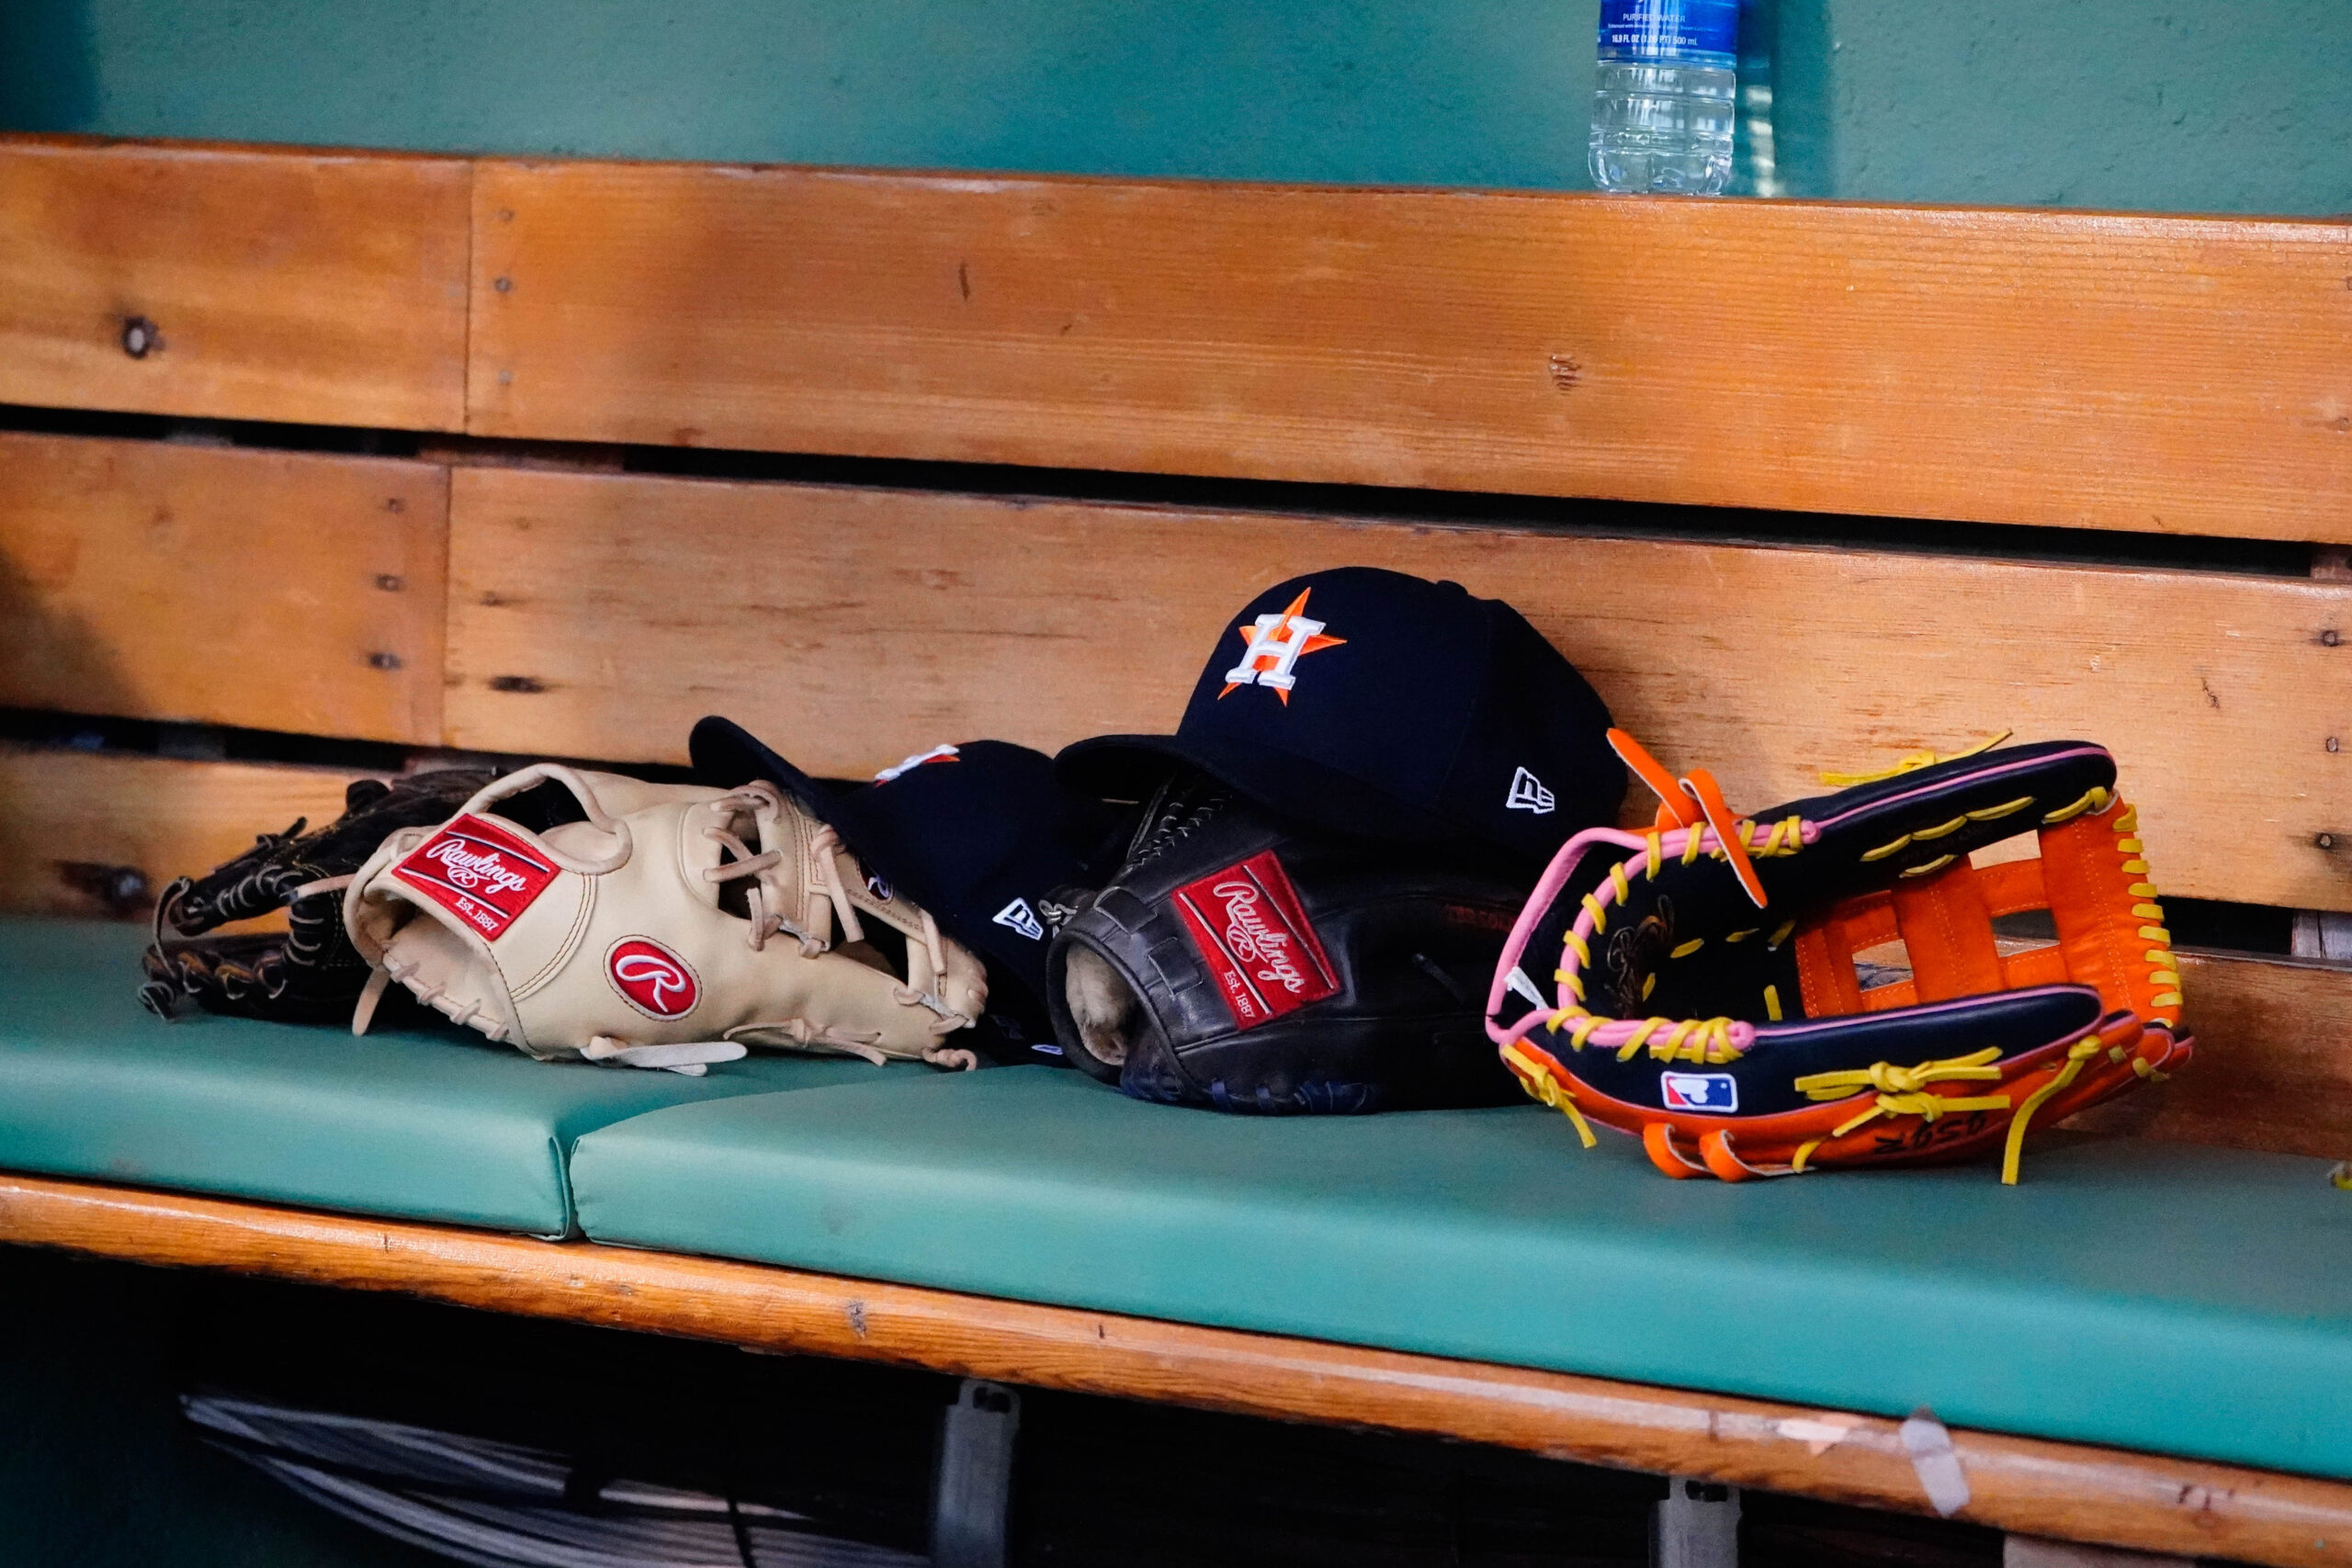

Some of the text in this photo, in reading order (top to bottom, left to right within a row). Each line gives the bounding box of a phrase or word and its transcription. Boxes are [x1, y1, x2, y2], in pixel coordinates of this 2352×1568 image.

[1623, 13, 1686, 23] PURIFIED WATER
[1623, 34, 1631, 43] FL
[1631, 34, 1640, 43] OZ
[1687, 38, 1698, 46] mL
[1225, 614, 1326, 691] H
[425, 838, 527, 894] Rawlings
[455, 897, 499, 931] Est. 1887
[1213, 881, 1306, 994] Rawlings
[615, 953, 686, 1013] R
[1223, 969, 1257, 1018] Est. 1887
